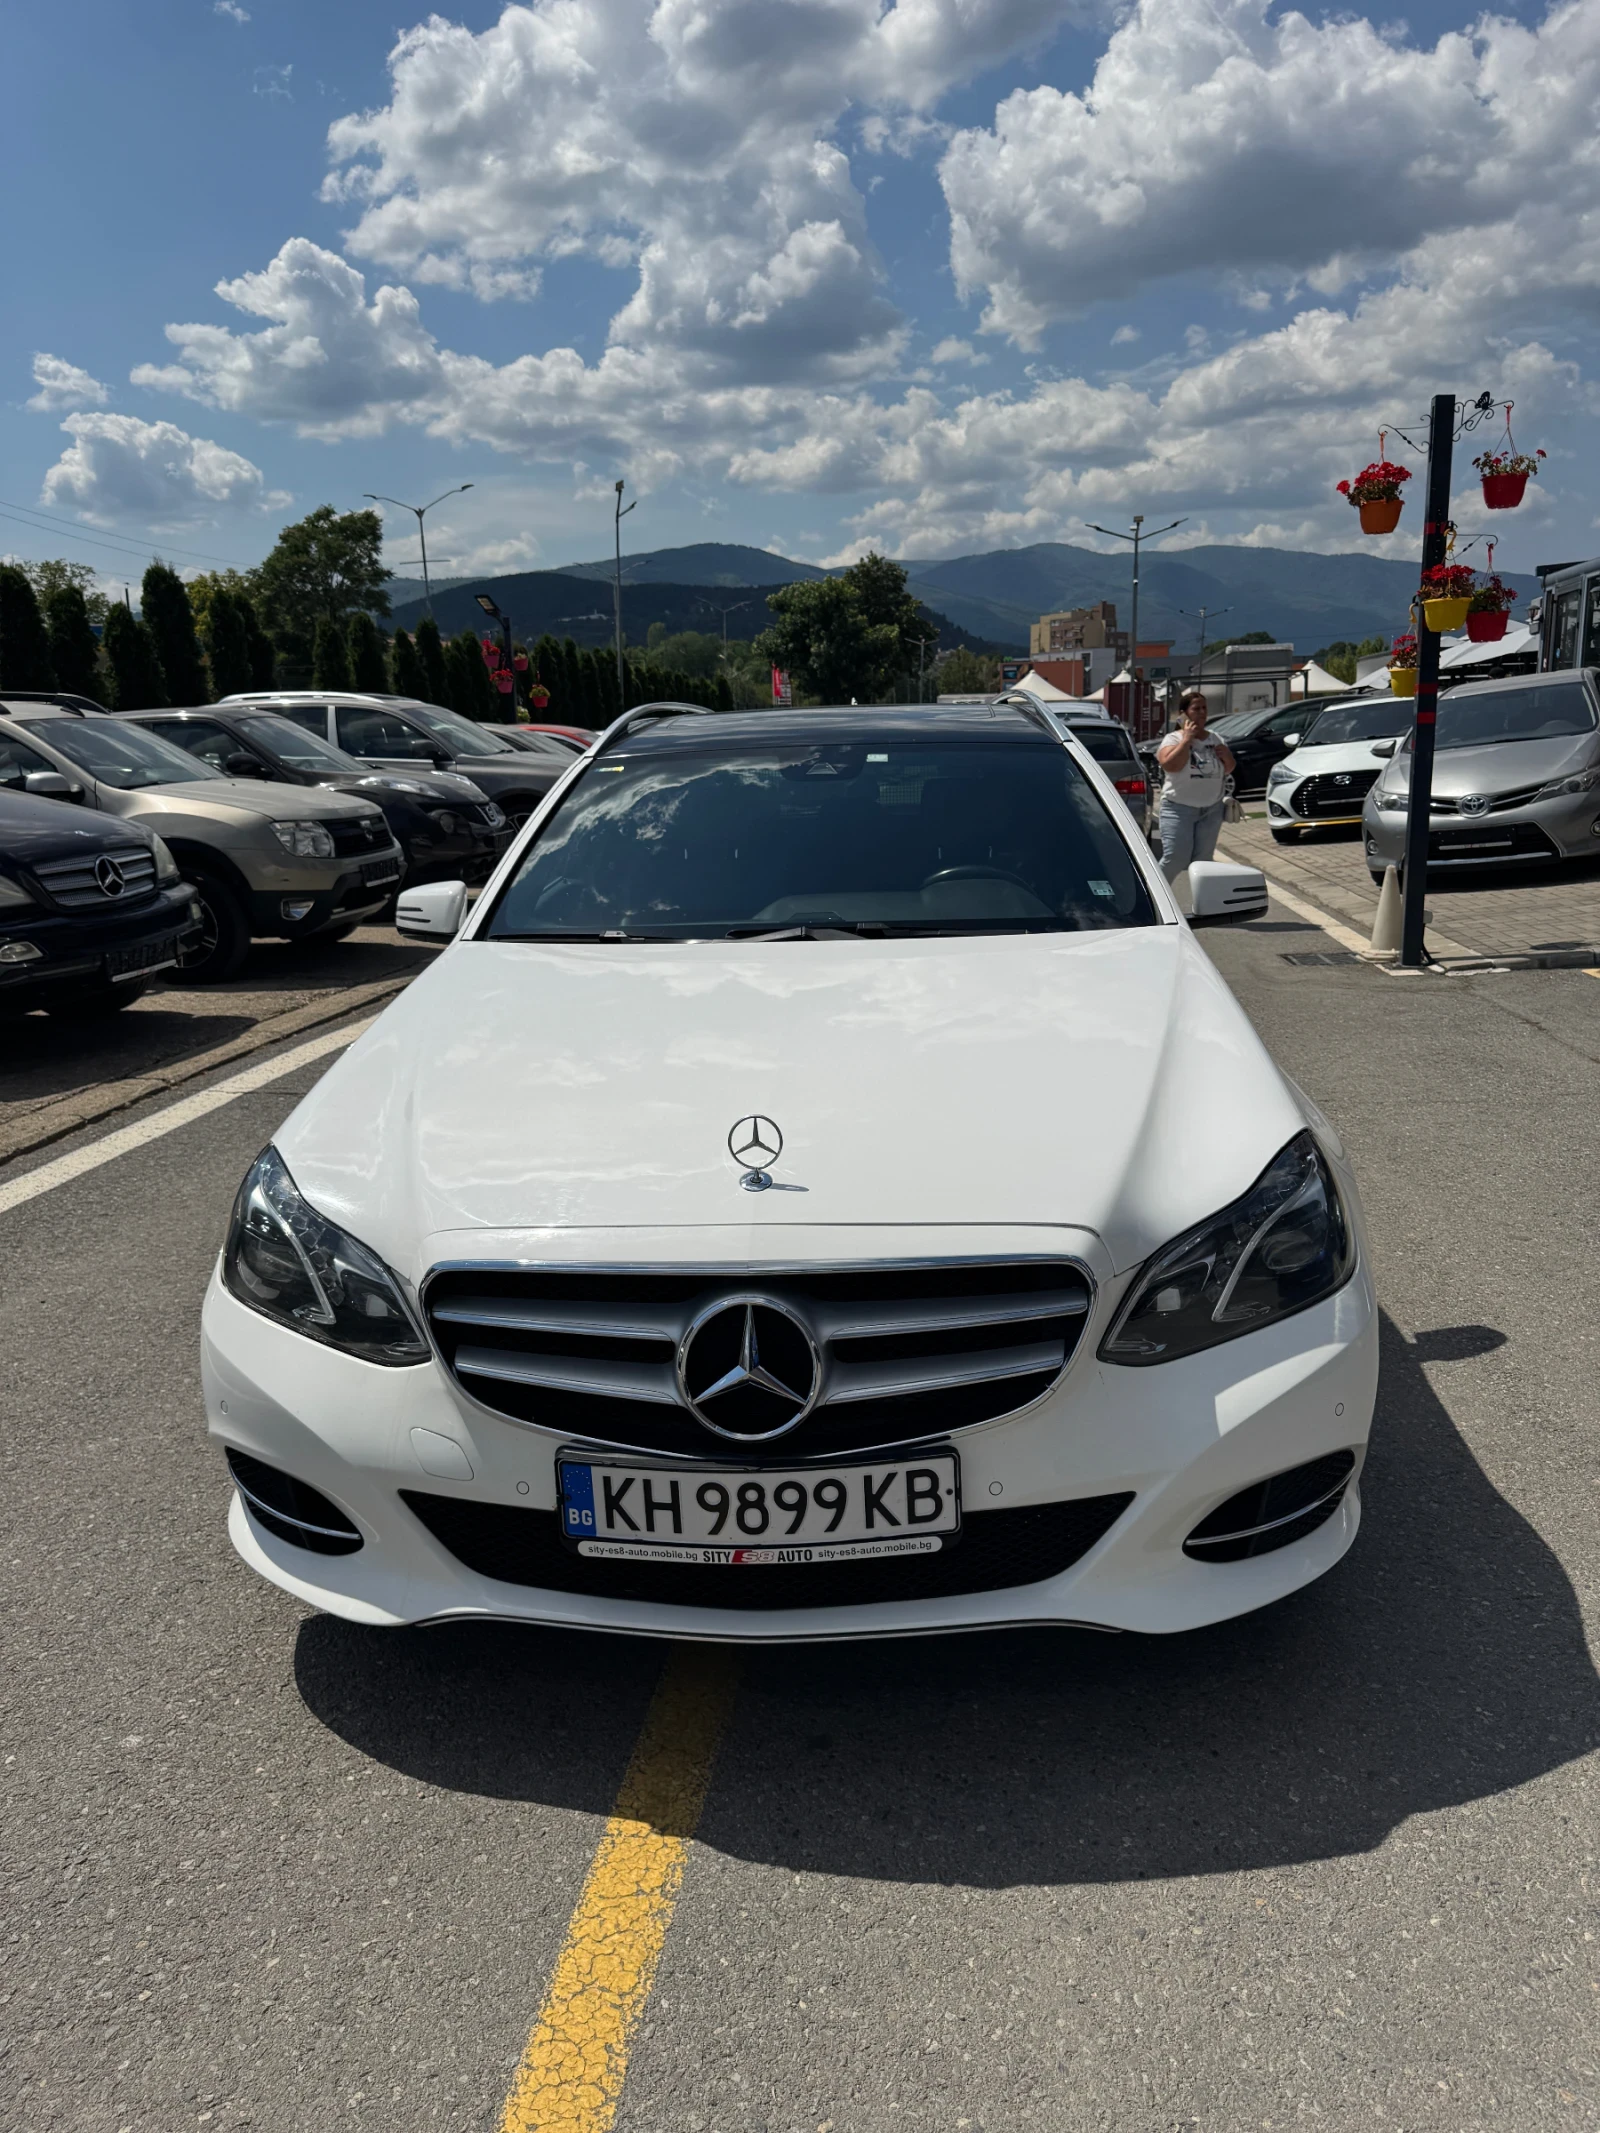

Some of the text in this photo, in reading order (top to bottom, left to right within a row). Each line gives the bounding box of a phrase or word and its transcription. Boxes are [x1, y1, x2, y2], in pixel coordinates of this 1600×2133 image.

[603, 1468, 943, 1536] KH 9899 KB
[568, 1508, 593, 1526] BG
[588, 1545, 698, 1561] sity-es8-auto.mobile.bg
[703, 1550, 731, 1563] SITY
[777, 1549, 813, 1563] AUTO
[818, 1541, 932, 1559] sity-es8-auto.mobile.bg
